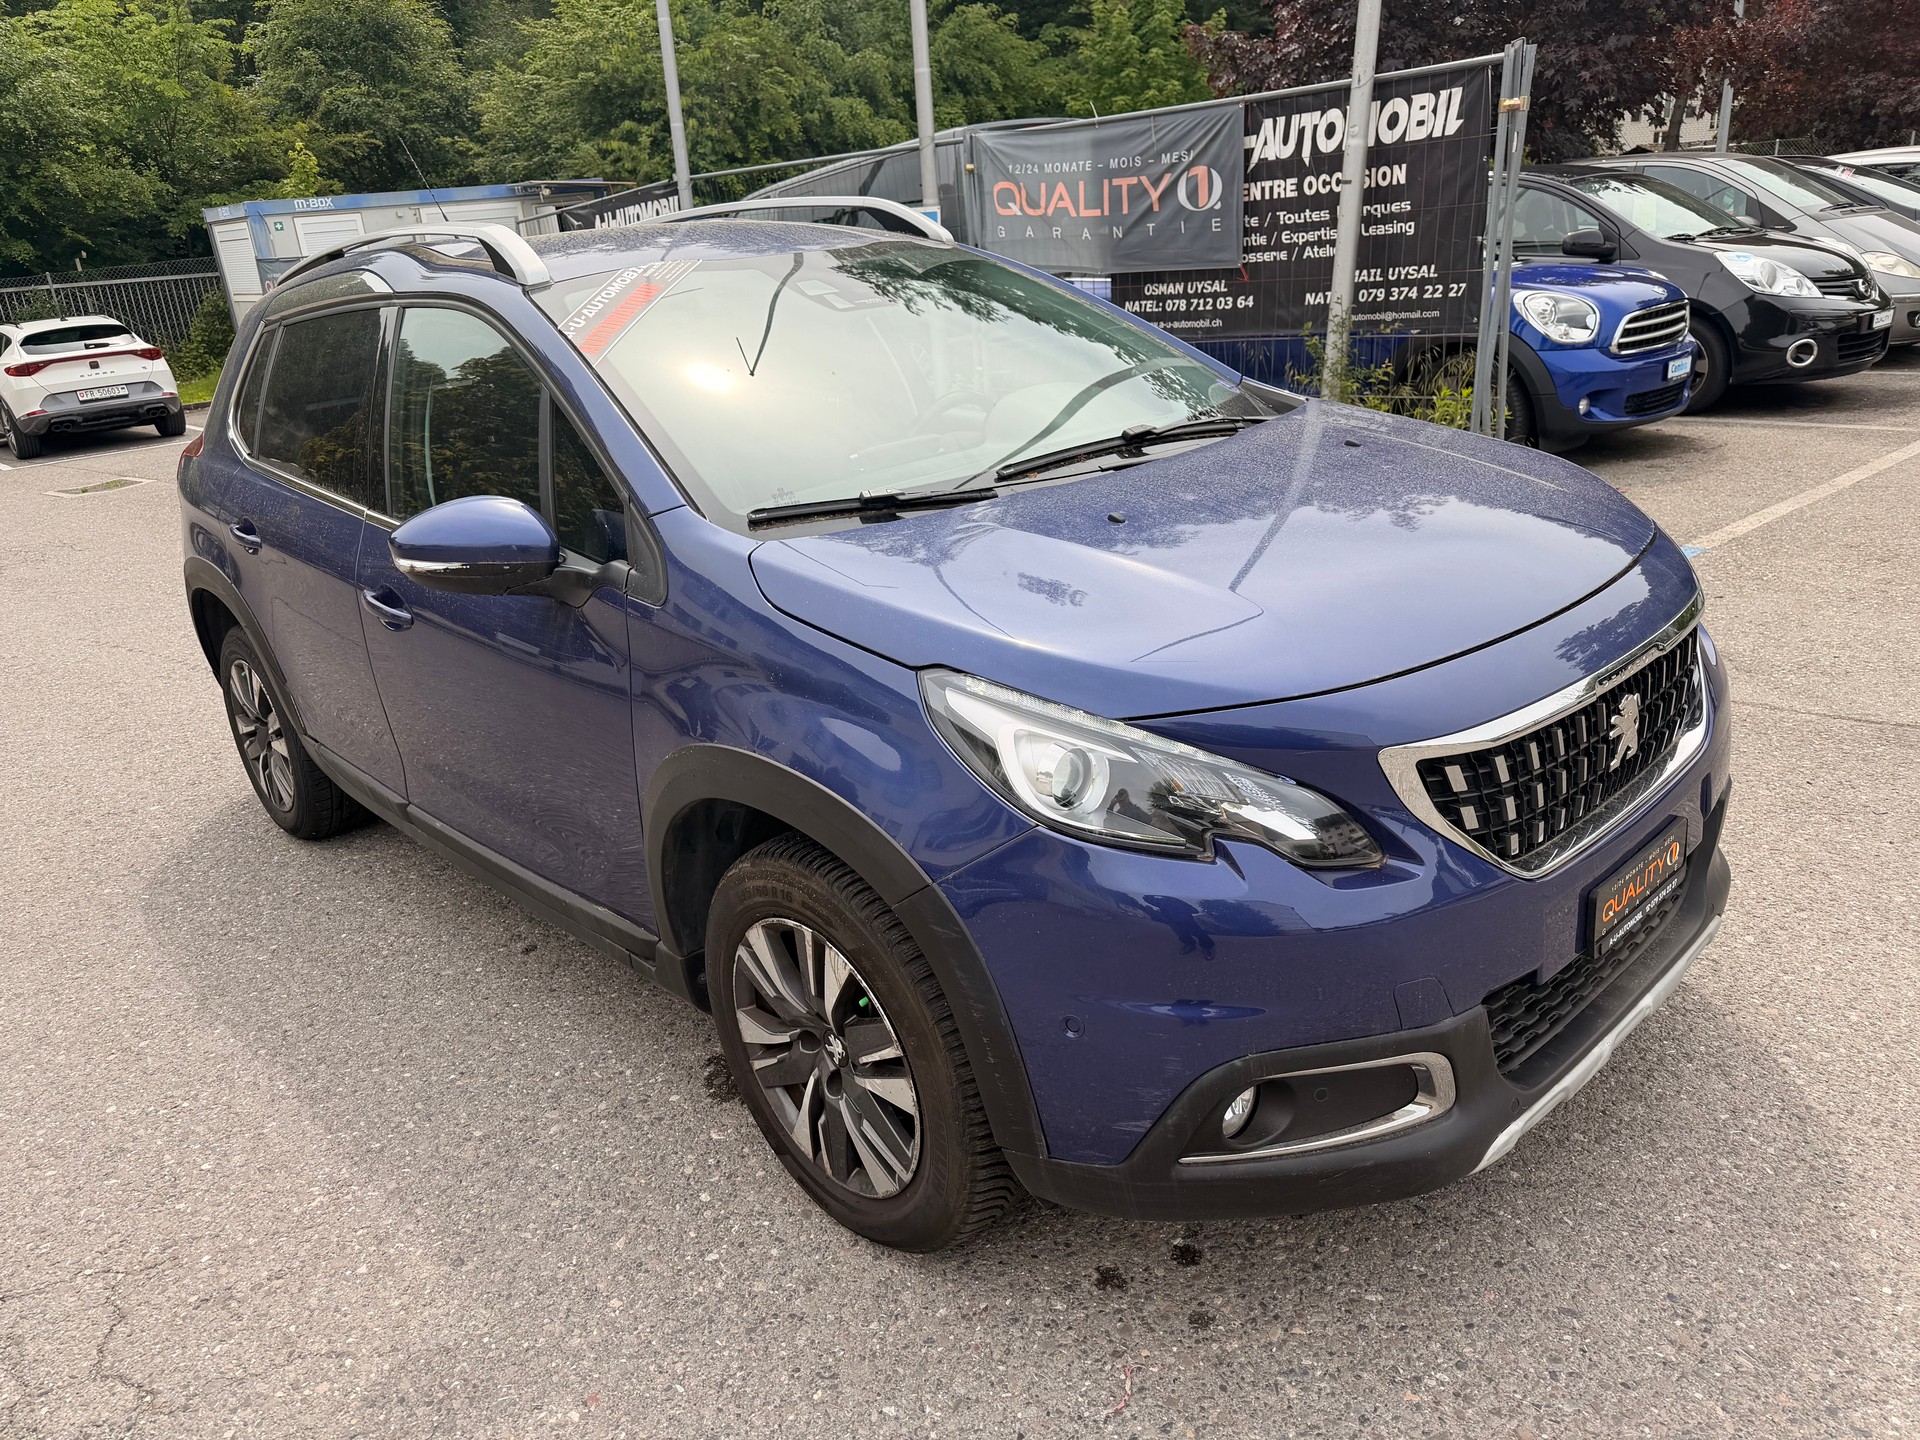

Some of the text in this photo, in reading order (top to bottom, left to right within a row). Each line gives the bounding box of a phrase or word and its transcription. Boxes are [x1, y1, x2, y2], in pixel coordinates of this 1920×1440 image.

[1007, 163, 1039, 174] 12/24
[1044, 160, 1092, 174] MONATE
[1109, 156, 1142, 169] MOIS
[1161, 150, 1194, 164] MESI
[1243, 163, 1407, 202] ENTRE OCCSION
[993, 172, 1172, 217] QUALITY
[1244, 214, 1259, 227] te
[1276, 208, 1330, 225] Toutes
[997, 218, 1222, 241] GARANTIE
[1243, 233, 1267, 247] ntie
[1281, 227, 1337, 245] Expertis
[1361, 220, 1415, 236] Leasing
[1242, 250, 1288, 263] osserie
[1354, 264, 1439, 283] AIL UYSAL
[1144, 280, 1228, 296] OSMAN UYSAL
[1304, 282, 1467, 306] NAT 079 374 22 27
[1124, 295, 1254, 313] NATEL: 078 712 03 64
[1351, 310, 1440, 321] automobil@hotmail.com
[1603, 852, 1667, 922] QUALITY
[1601, 864, 1678, 936] GARANTIE
